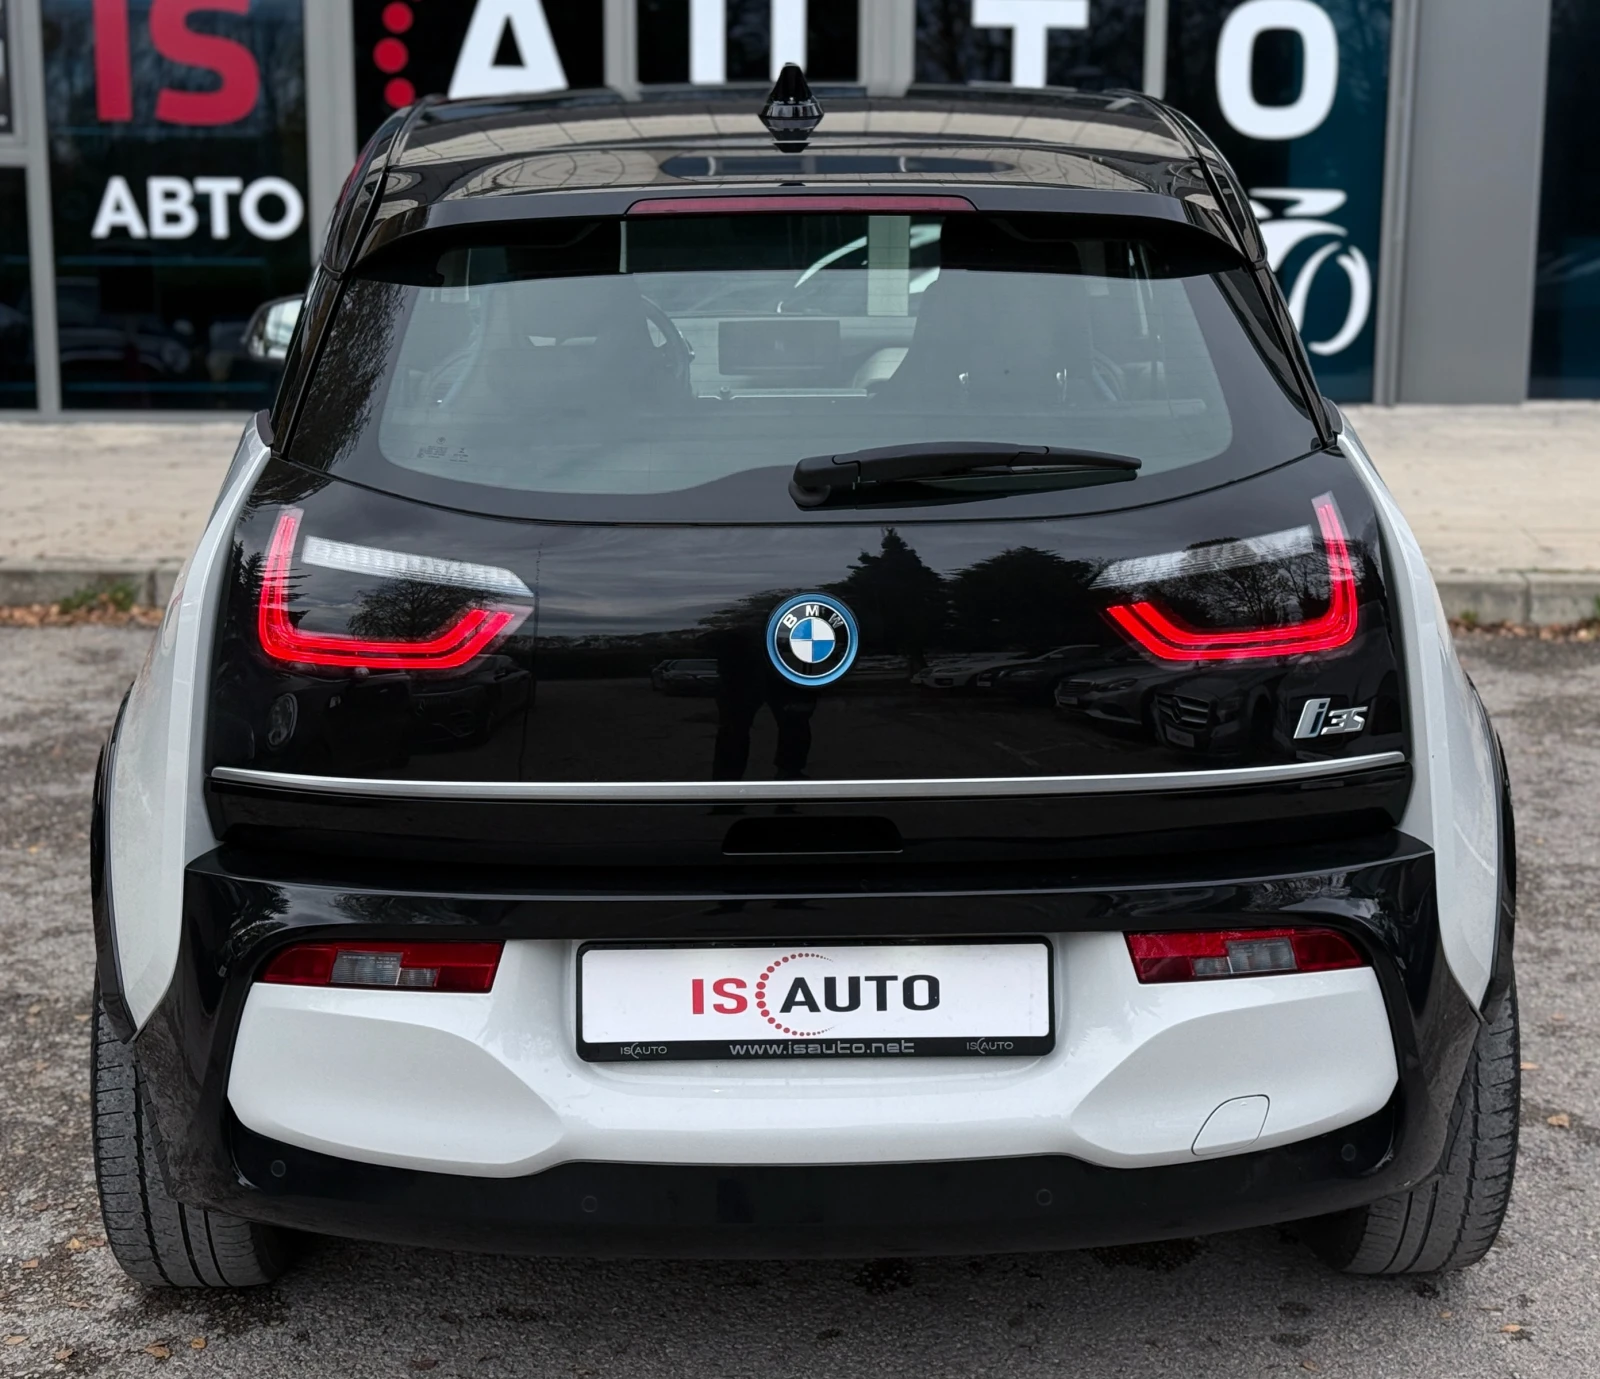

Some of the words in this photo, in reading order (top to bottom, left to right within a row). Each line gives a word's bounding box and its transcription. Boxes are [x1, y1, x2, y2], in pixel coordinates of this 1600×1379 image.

[94, 0, 259, 126] IS
[92, 175, 304, 241] АВТО
[782, 604, 845, 629] BMW
[691, 977, 748, 1015] IS
[778, 974, 941, 1014] AUTO
[729, 1039, 916, 1056] www.isauto.net
